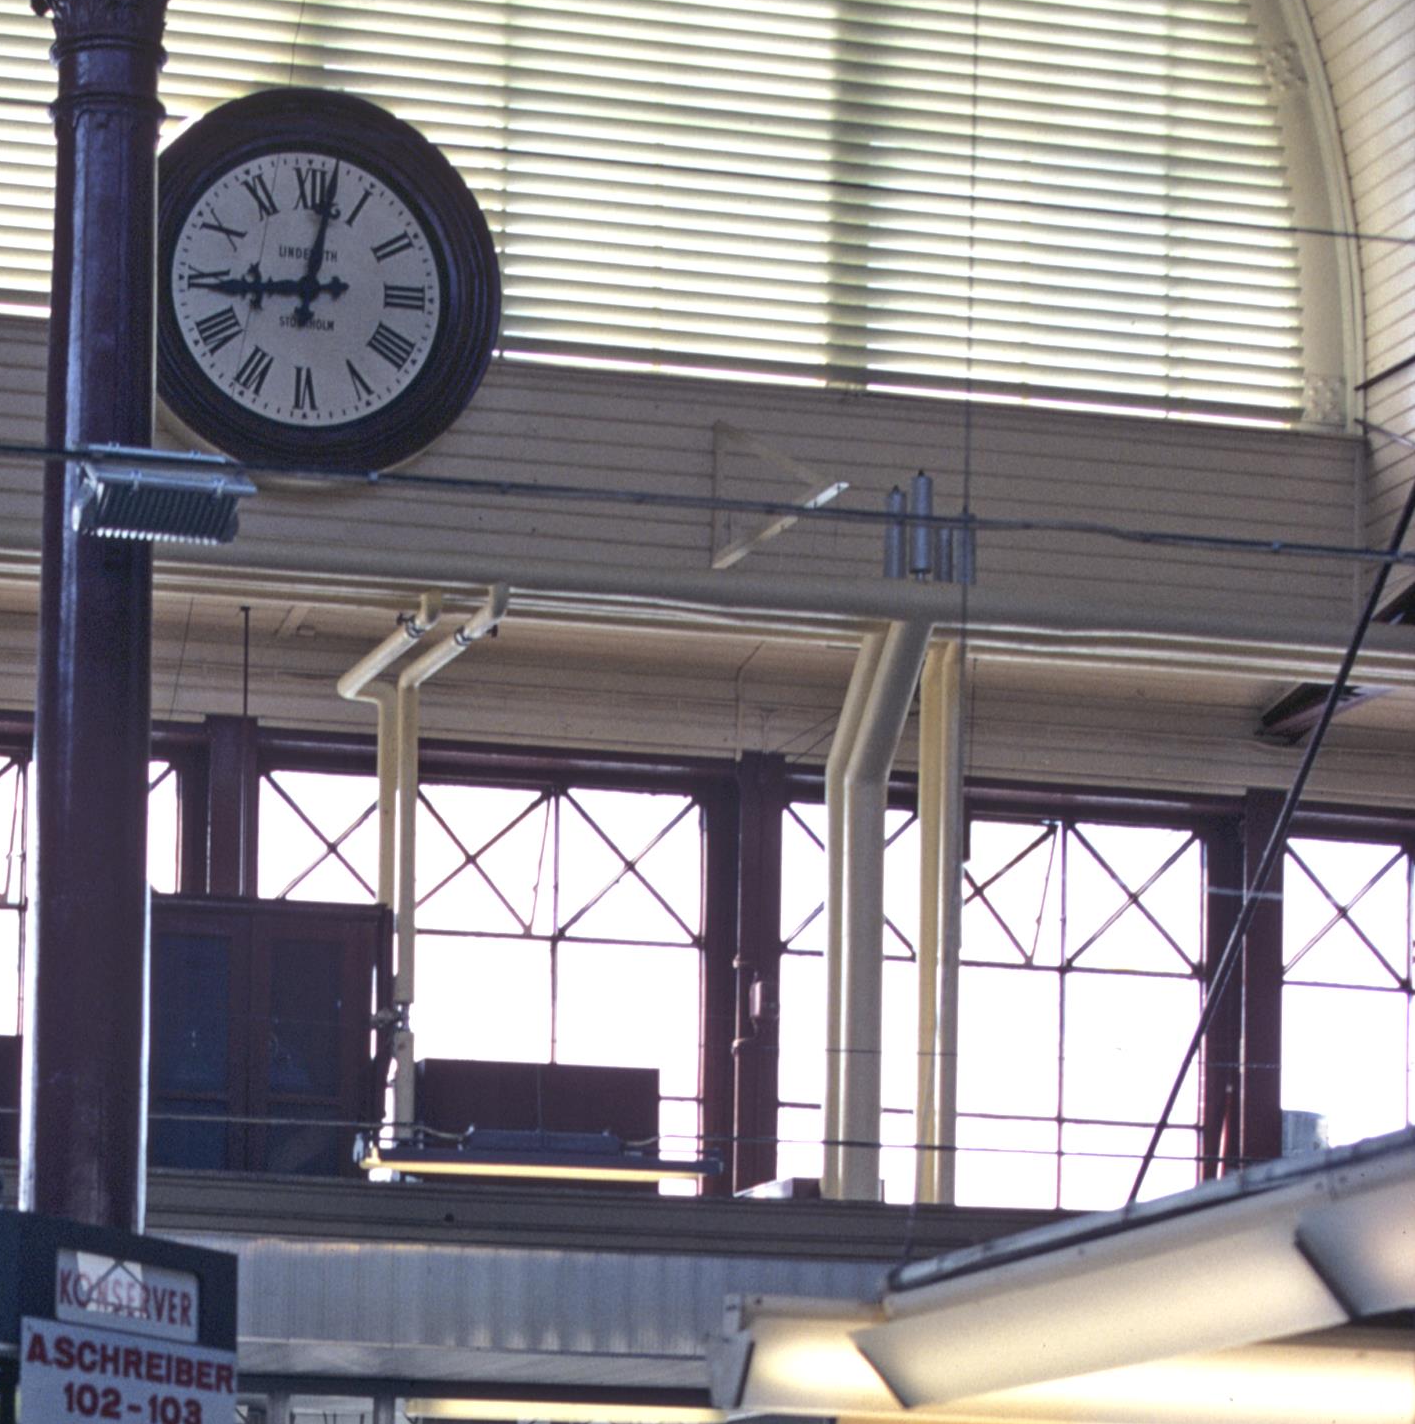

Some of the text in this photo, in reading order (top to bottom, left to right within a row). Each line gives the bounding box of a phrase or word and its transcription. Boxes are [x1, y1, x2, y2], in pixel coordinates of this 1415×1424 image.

[279, 245, 337, 263] LINDETH
[280, 317, 334, 331] STOHOLM
[60, 1270, 192, 1327] KONSERVER
